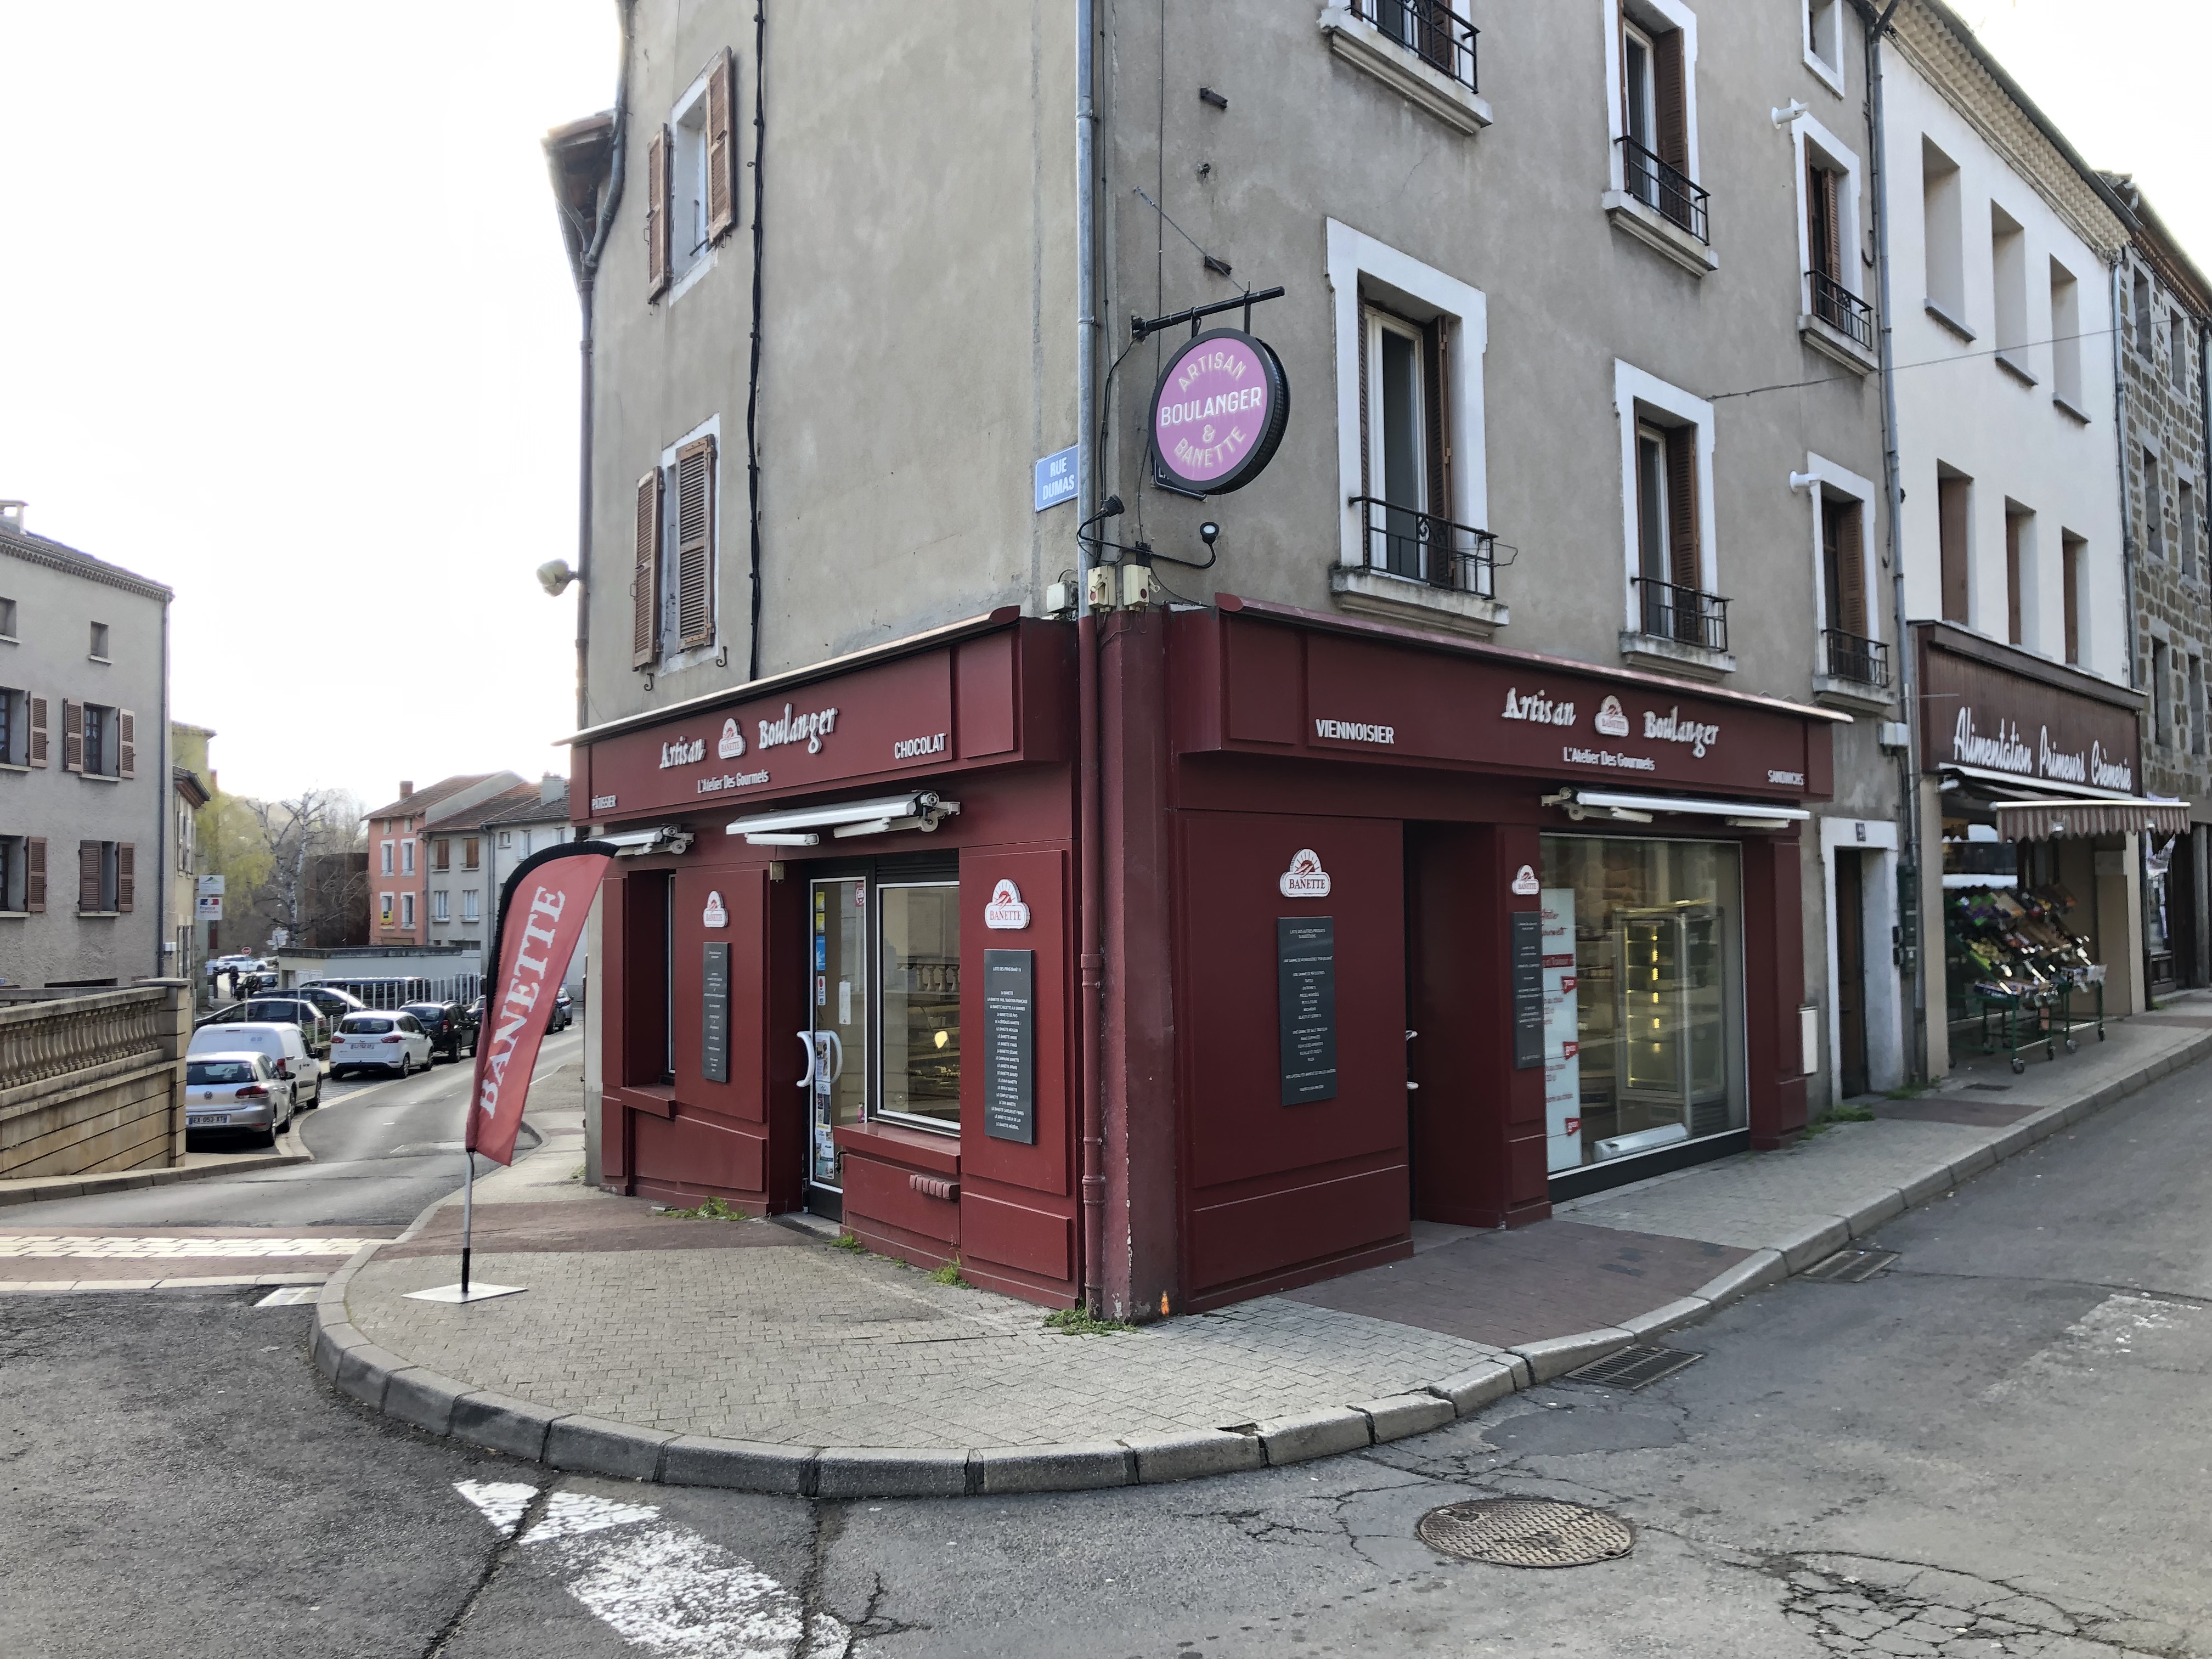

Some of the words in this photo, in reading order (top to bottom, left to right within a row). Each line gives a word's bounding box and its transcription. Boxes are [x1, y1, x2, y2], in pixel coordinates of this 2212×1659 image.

[1178, 352, 1246, 392] ARTISAN
[1160, 387, 1261, 427] BOULANGER
[1173, 425, 1246, 469] BANETTE
[1202, 424, 1216, 444] &
[1049, 457, 1068, 477] RUE
[1042, 474, 1075, 501] DUMAS
[1502, 686, 1577, 726] Artisan
[659, 736, 706, 769] Artisan
[759, 702, 838, 754] Boulanger
[1315, 719, 1395, 744] VIENNOISIER
[1643, 706, 1719, 758] Boulanger
[1953, 706, 2033, 774] Alimentation
[2039, 724, 2086, 783] Primeurs
[894, 732, 946, 759] CHOCOLAT
[1600, 751, 1617, 767] Des
[1617, 753, 1656, 771] Gourmets
[724, 774, 736, 789] Des
[736, 769, 770, 787] Gourmets
[1289, 878, 1326, 889] BANETTE
[989, 910, 1022, 921] BANETTE
[480, 885, 566, 1119] BANETTE
